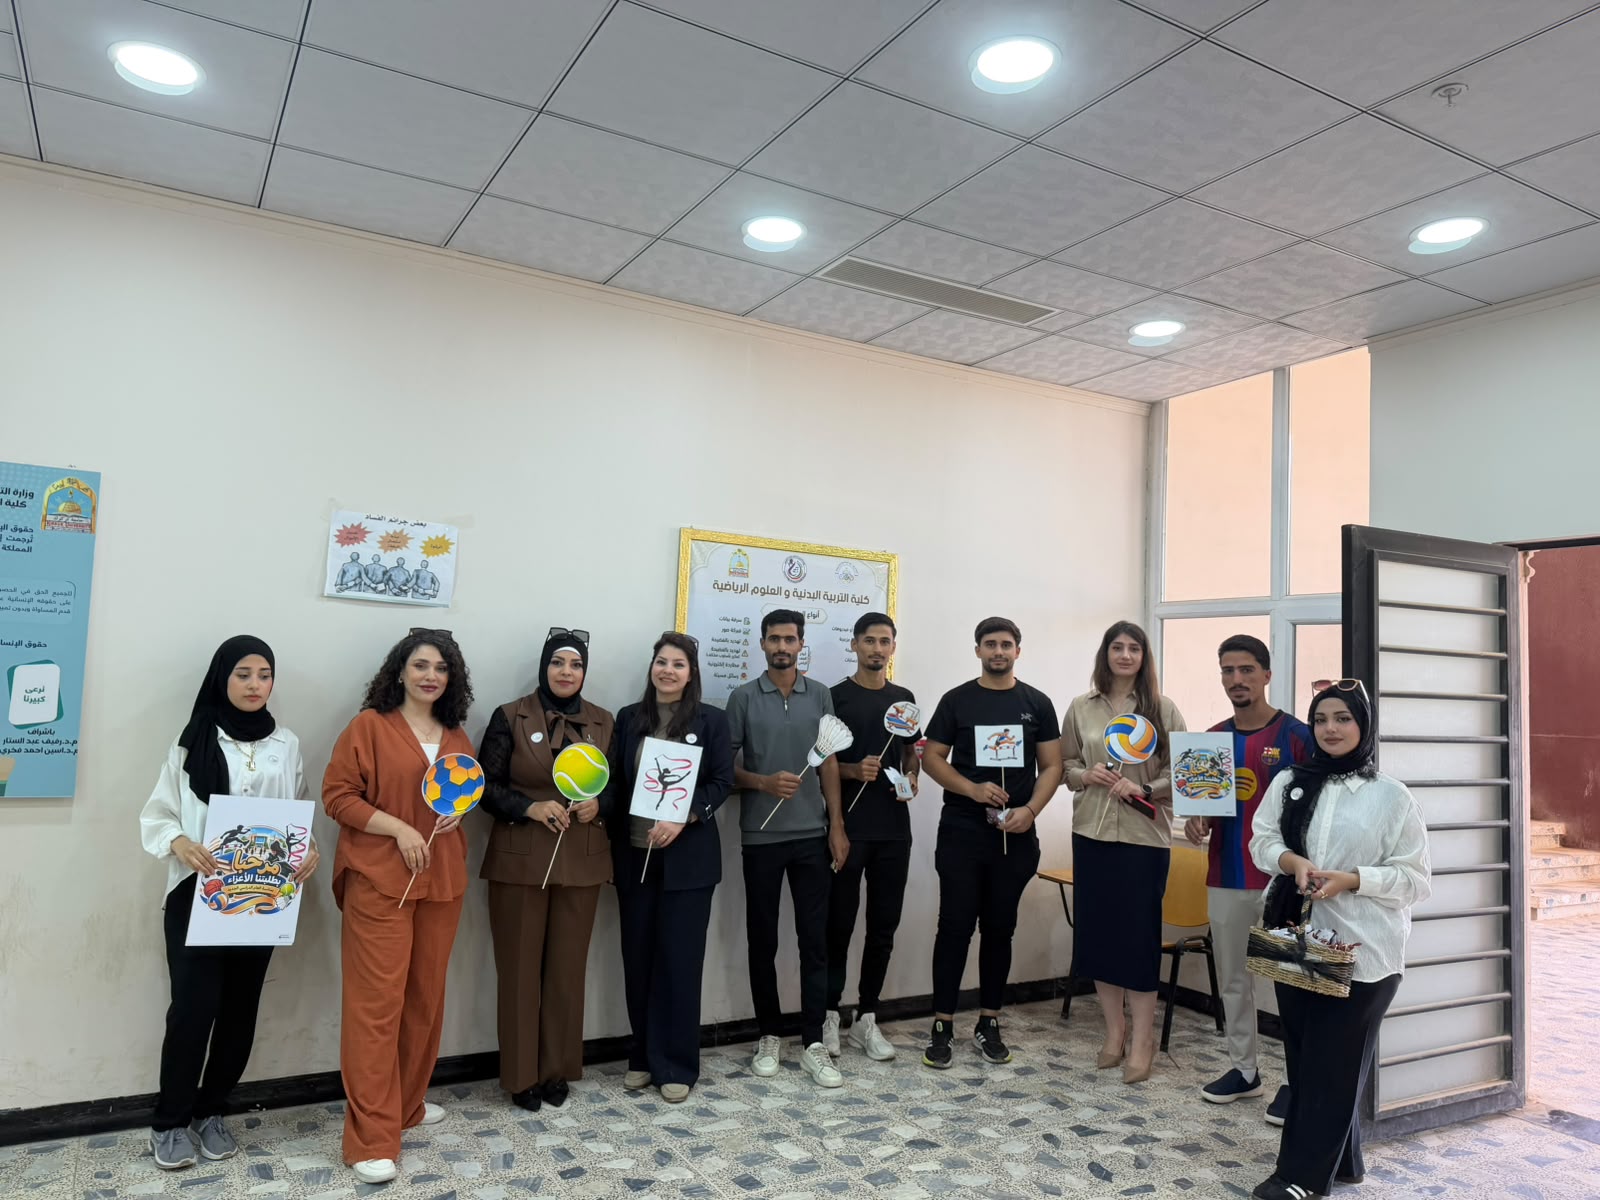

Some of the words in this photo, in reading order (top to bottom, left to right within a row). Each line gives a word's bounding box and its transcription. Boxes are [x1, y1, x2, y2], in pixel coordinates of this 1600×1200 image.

[12, 488, 34, 499] وزارة
[5, 499, 27, 508] كلية
[365, 513, 386, 521] الفساد
[388, 515, 408, 525] جرائم
[10, 524, 34, 533] حقوق
[410, 520, 427, 528] بعض
[1, 544, 33, 553] المملكة
[713, 580, 749, 594] الرياضية
[751, 586, 782, 597] العلوم
[51, 590, 72, 598] للجميع
[784, 590, 790, 599] و
[793, 587, 821, 600] البدنية
[823, 591, 849, 604] التربية
[37, 597, 56, 605] حقوقه
[851, 594, 870, 605] كلية
[24, 640, 48, 649] حقوق
[23, 695, 46, 704] كبيرنا
[27, 728, 55, 737] باشراف
[2, 737, 25, 745] الستار
[233, 848, 281, 875] مرحبا
[227, 872, 254, 884] الأعزاء
[255, 874, 281, 887] بطلبتنا
